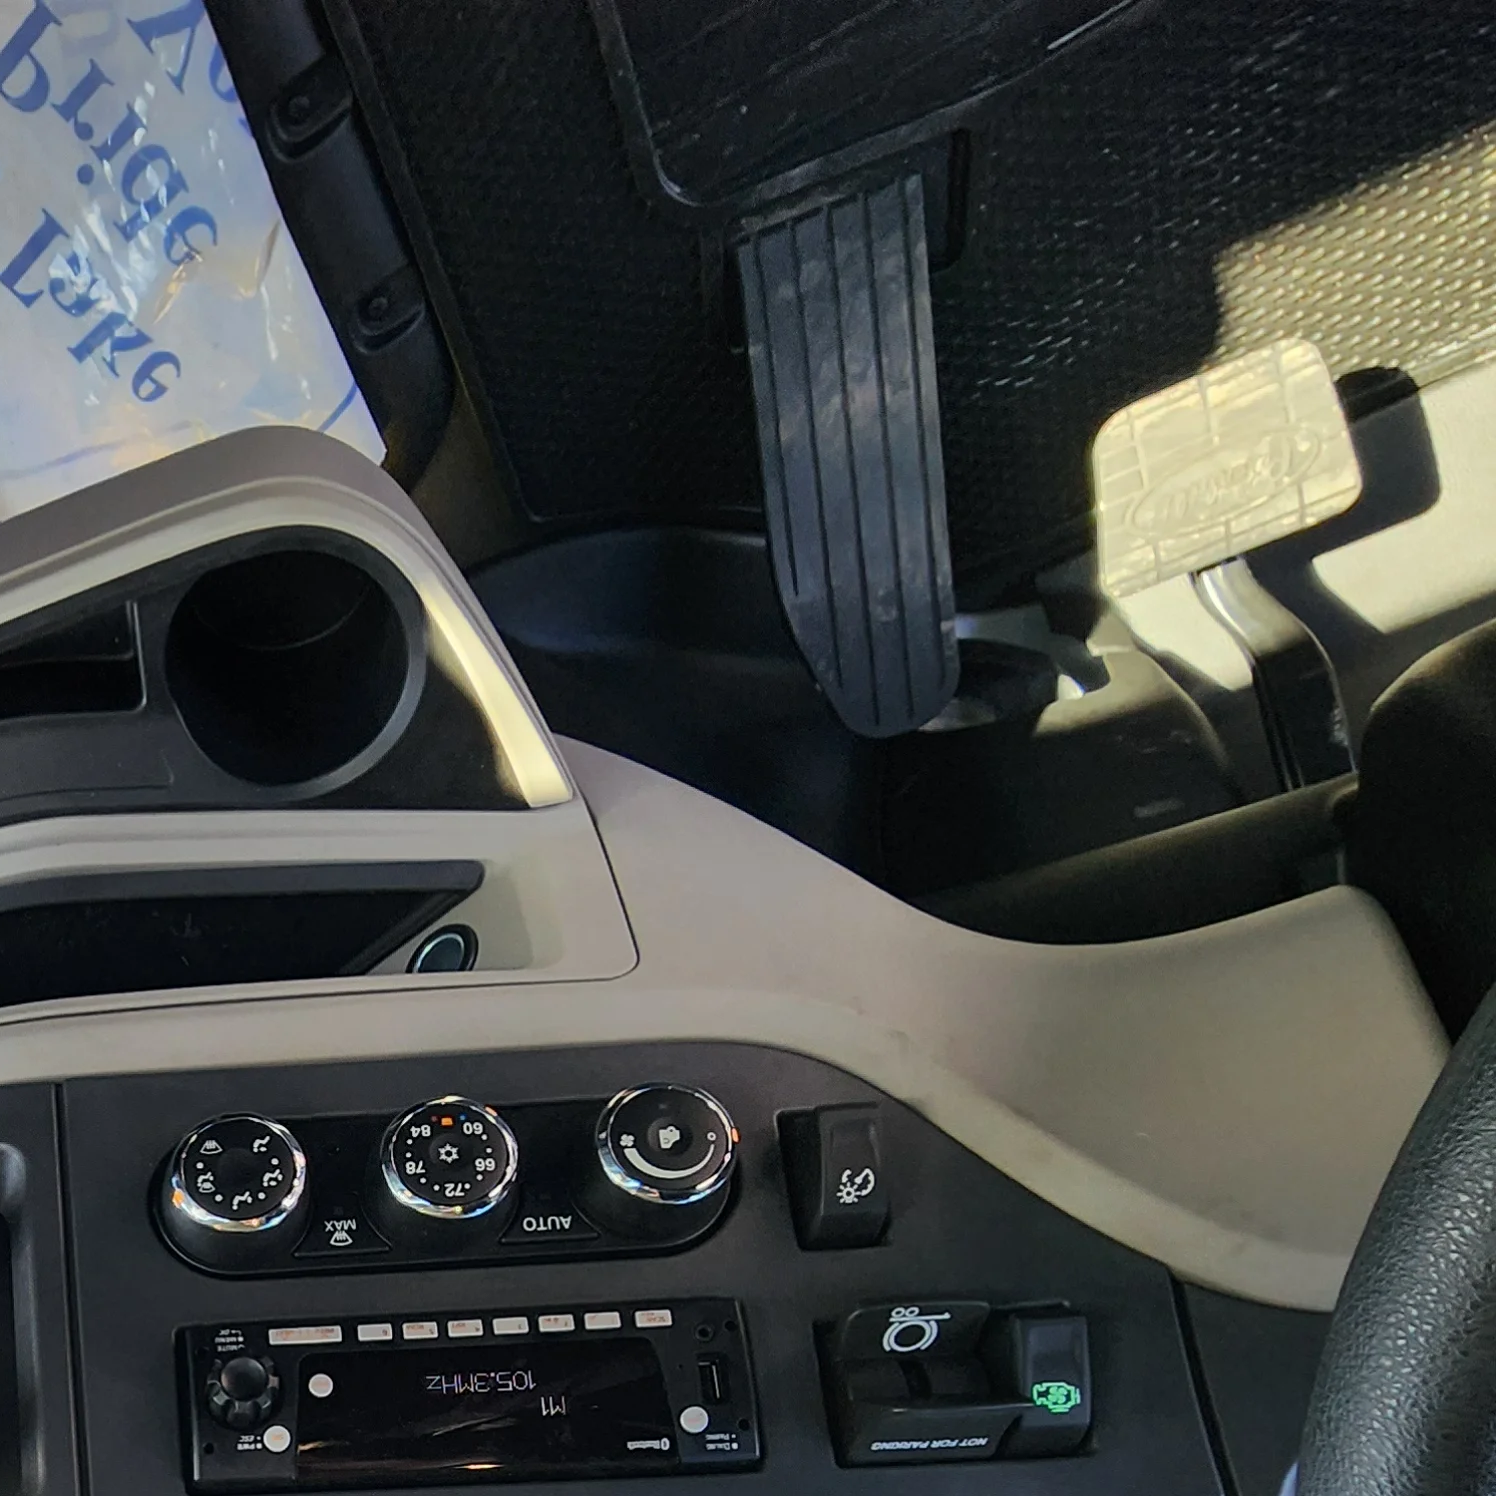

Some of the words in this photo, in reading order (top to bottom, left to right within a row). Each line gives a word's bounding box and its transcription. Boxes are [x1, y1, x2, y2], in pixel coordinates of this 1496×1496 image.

[410, 1124, 431, 1138] 84
[463, 1121, 484, 1135] 60
[405, 1161, 426, 1174] 78
[474, 1158, 496, 1171] 66
[444, 1182, 465, 1196] 72
[324, 1219, 357, 1232] MAX
[522, 1215, 572, 1231] AUTO
[425, 1369, 537, 1394] 105.3MHz
[540, 1395, 566, 1416] M1
[870, 1440, 930, 1450] PARKING
[930, 1439, 958, 1448] FOR
[958, 1437, 988, 1446] NOT
